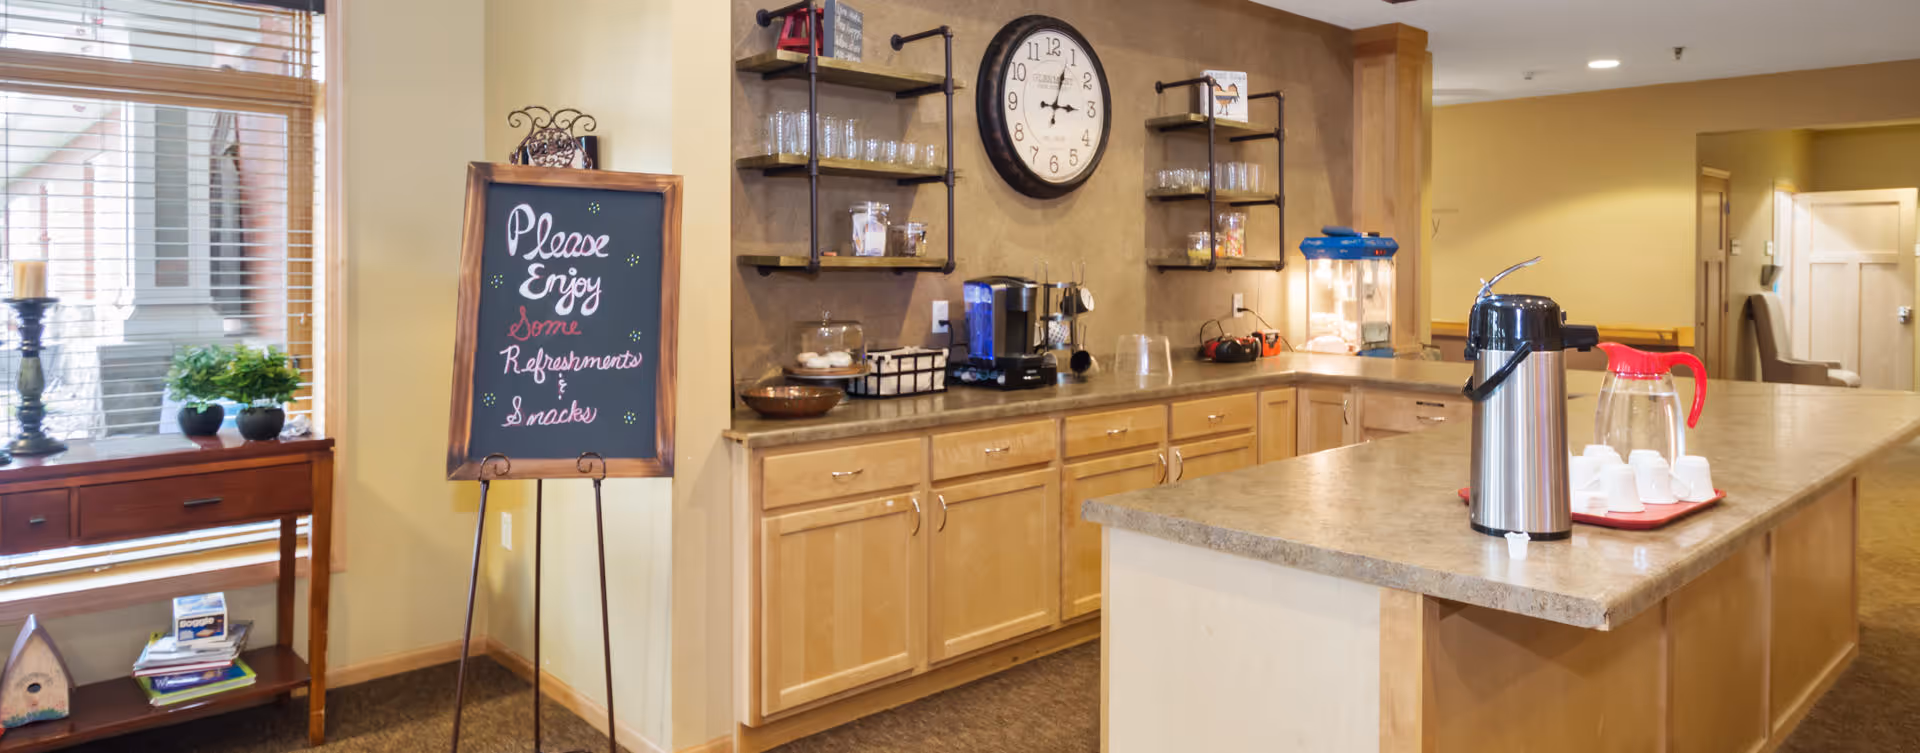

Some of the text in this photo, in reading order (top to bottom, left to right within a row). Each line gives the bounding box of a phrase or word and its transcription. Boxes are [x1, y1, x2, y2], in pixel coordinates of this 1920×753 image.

[1027, 41, 1041, 61] 11
[1045, 36, 1061, 57] 12
[1070, 48, 1077, 67] 1
[1011, 61, 1027, 82] 10
[1082, 71, 1093, 91] 2
[1007, 91, 1018, 111] 9
[1087, 100, 1097, 119] 3
[1014, 122, 1025, 142] 8
[1081, 129, 1091, 147] 4
[1030, 145, 1039, 165] 7
[1049, 154, 1059, 174] 6
[1068, 148, 1079, 167] 5
[507, 203, 610, 261] Please
[518, 262, 603, 317] Enjoy
[507, 305, 583, 342] Some
[499, 344, 643, 385] Refreshments
[501, 395, 598, 428] Snacks
